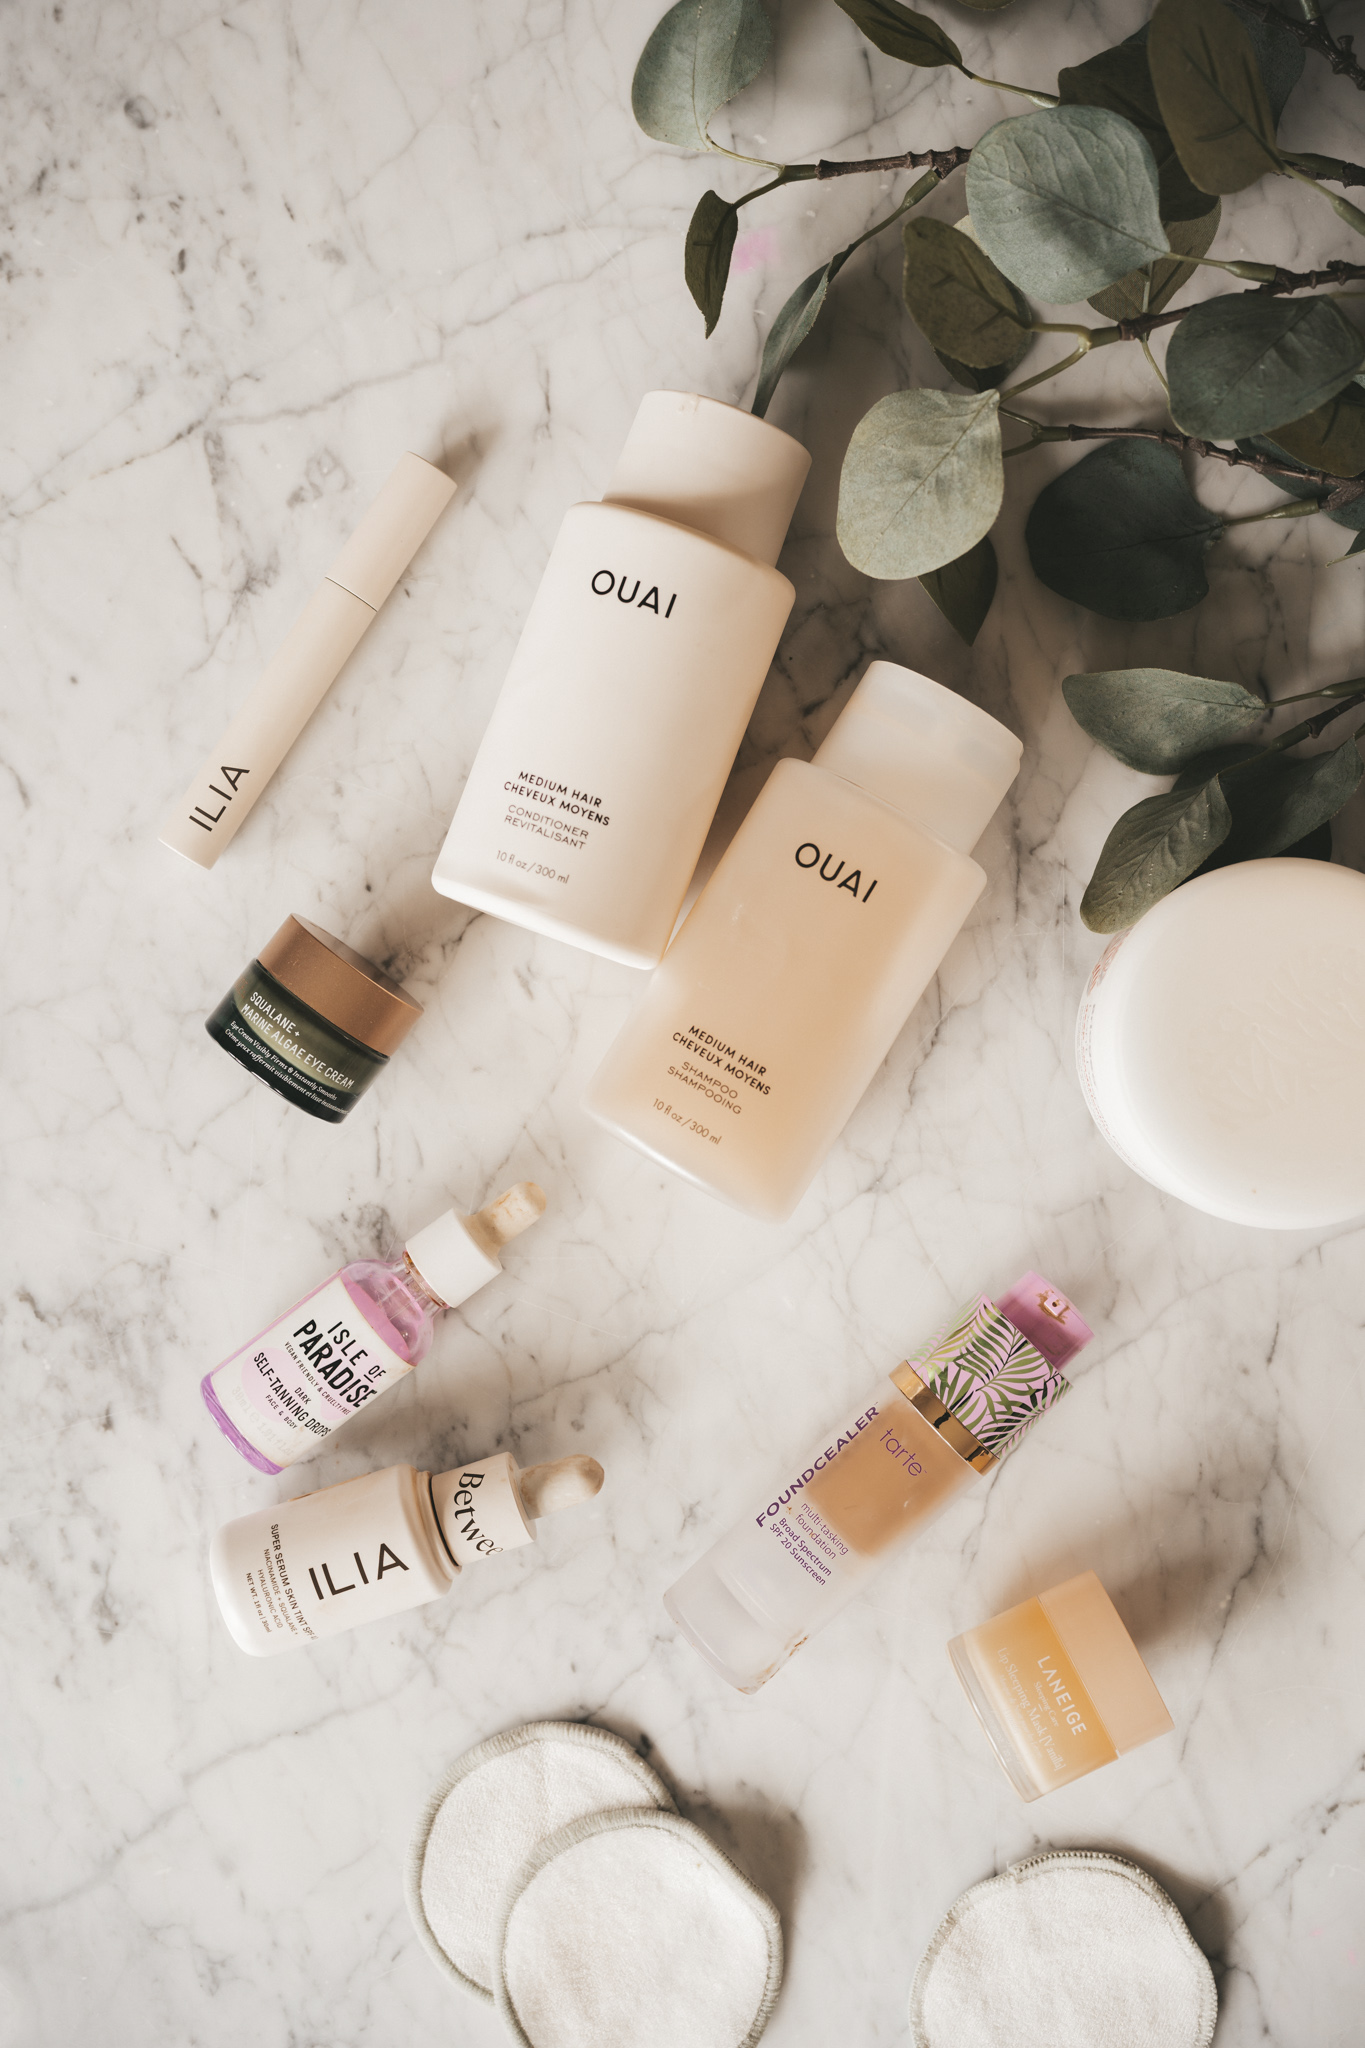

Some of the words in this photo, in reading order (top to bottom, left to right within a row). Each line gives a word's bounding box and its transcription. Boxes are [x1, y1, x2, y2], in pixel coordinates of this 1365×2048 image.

[591, 570, 677, 618] OUAI
[189, 766, 250, 832] ILIA
[504, 781, 556, 806] CHEVEUX
[559, 801, 610, 826] MOYENS
[518, 771, 569, 796] MEDIUM
[571, 790, 602, 808] HAIR
[504, 815, 586, 850] REVITALISANT
[508, 804, 589, 839] CONDITIONER
[496, 851, 507, 862] 10
[557, 875, 570, 885] ml
[795, 843, 878, 903] OUAI
[250, 992, 296, 1033] SQUALANE
[231, 1021, 239, 1030] Eye
[238, 1026, 254, 1043] Cream
[252, 1041, 272, 1059] Visibly
[271, 1055, 288, 1070] Firms
[293, 1070, 322, 1091] Instantly
[236, 1040, 251, 1054] yeux
[249, 1052, 275, 1073] raffermit
[274, 1069, 306, 1094] visiblement
[241, 1004, 274, 1034] MARINE
[271, 1031, 306, 1059] ALGAE
[304, 1054, 326, 1073] EYE
[324, 1068, 354, 1089] CREAM
[672, 1032, 723, 1067] CHEVEUX
[724, 1063, 771, 1095] MOYENS
[688, 1025, 736, 1058] MEDIUM
[738, 1054, 767, 1076] HAIR
[667, 1066, 742, 1114] SHAMPOOING
[682, 1061, 738, 1099] SHAMPOO
[653, 1098, 665, 1111] 10
[709, 1134, 722, 1145] ml
[293, 1319, 377, 1408] PARADISE
[328, 1321, 368, 1366] ISLE
[368, 1365, 386, 1379] OF
[254, 1352, 309, 1422] SELF-TANNING
[304, 1418, 331, 1437] DROPS
[284, 1342, 298, 1363] VEGAN
[296, 1360, 319, 1388] FRIENDLY
[321, 1391, 342, 1411] CRUELTY
[340, 1406, 351, 1416] FREE
[294, 1387, 312, 1405] DARK
[265, 1394, 279, 1410] FACE
[284, 1416, 298, 1430] BODY
[756, 1406, 880, 1527] FOUNDCEALER
[880, 1428, 923, 1476] tarte
[271, 1523, 281, 1551] SUPER
[779, 1518, 800, 1542] Broad
[798, 1540, 832, 1576] Spectrum
[795, 1513, 836, 1560] foundation
[800, 1503, 849, 1556] multi-tasking
[274, 1551, 289, 1587] SERUM
[308, 1543, 410, 1600] ILIA
[769, 1523, 784, 1538] SPF
[781, 1538, 792, 1549] 20
[790, 1548, 826, 1585] Sunscreen
[246, 1573, 254, 1587] NET
[258, 1569, 278, 1615] HYALURONIC
[273, 1615, 283, 1629] ACID
[264, 1548, 280, 1595] NIACINAMIDE
[279, 1602, 296, 1632] SQUALANE
[285, 1587, 298, 1609] SKIN
[295, 1609, 307, 1629] TINT
[303, 1626, 315, 1639] SPF
[997, 1647, 1008, 1664] Lip
[1006, 1664, 1030, 1708] Sleeping
[1028, 1708, 1048, 1736] Mask
[1034, 1681, 1050, 1711] Sleeping
[1048, 1710, 1058, 1727] Care
[1038, 1656, 1087, 1735] LANEIGE
